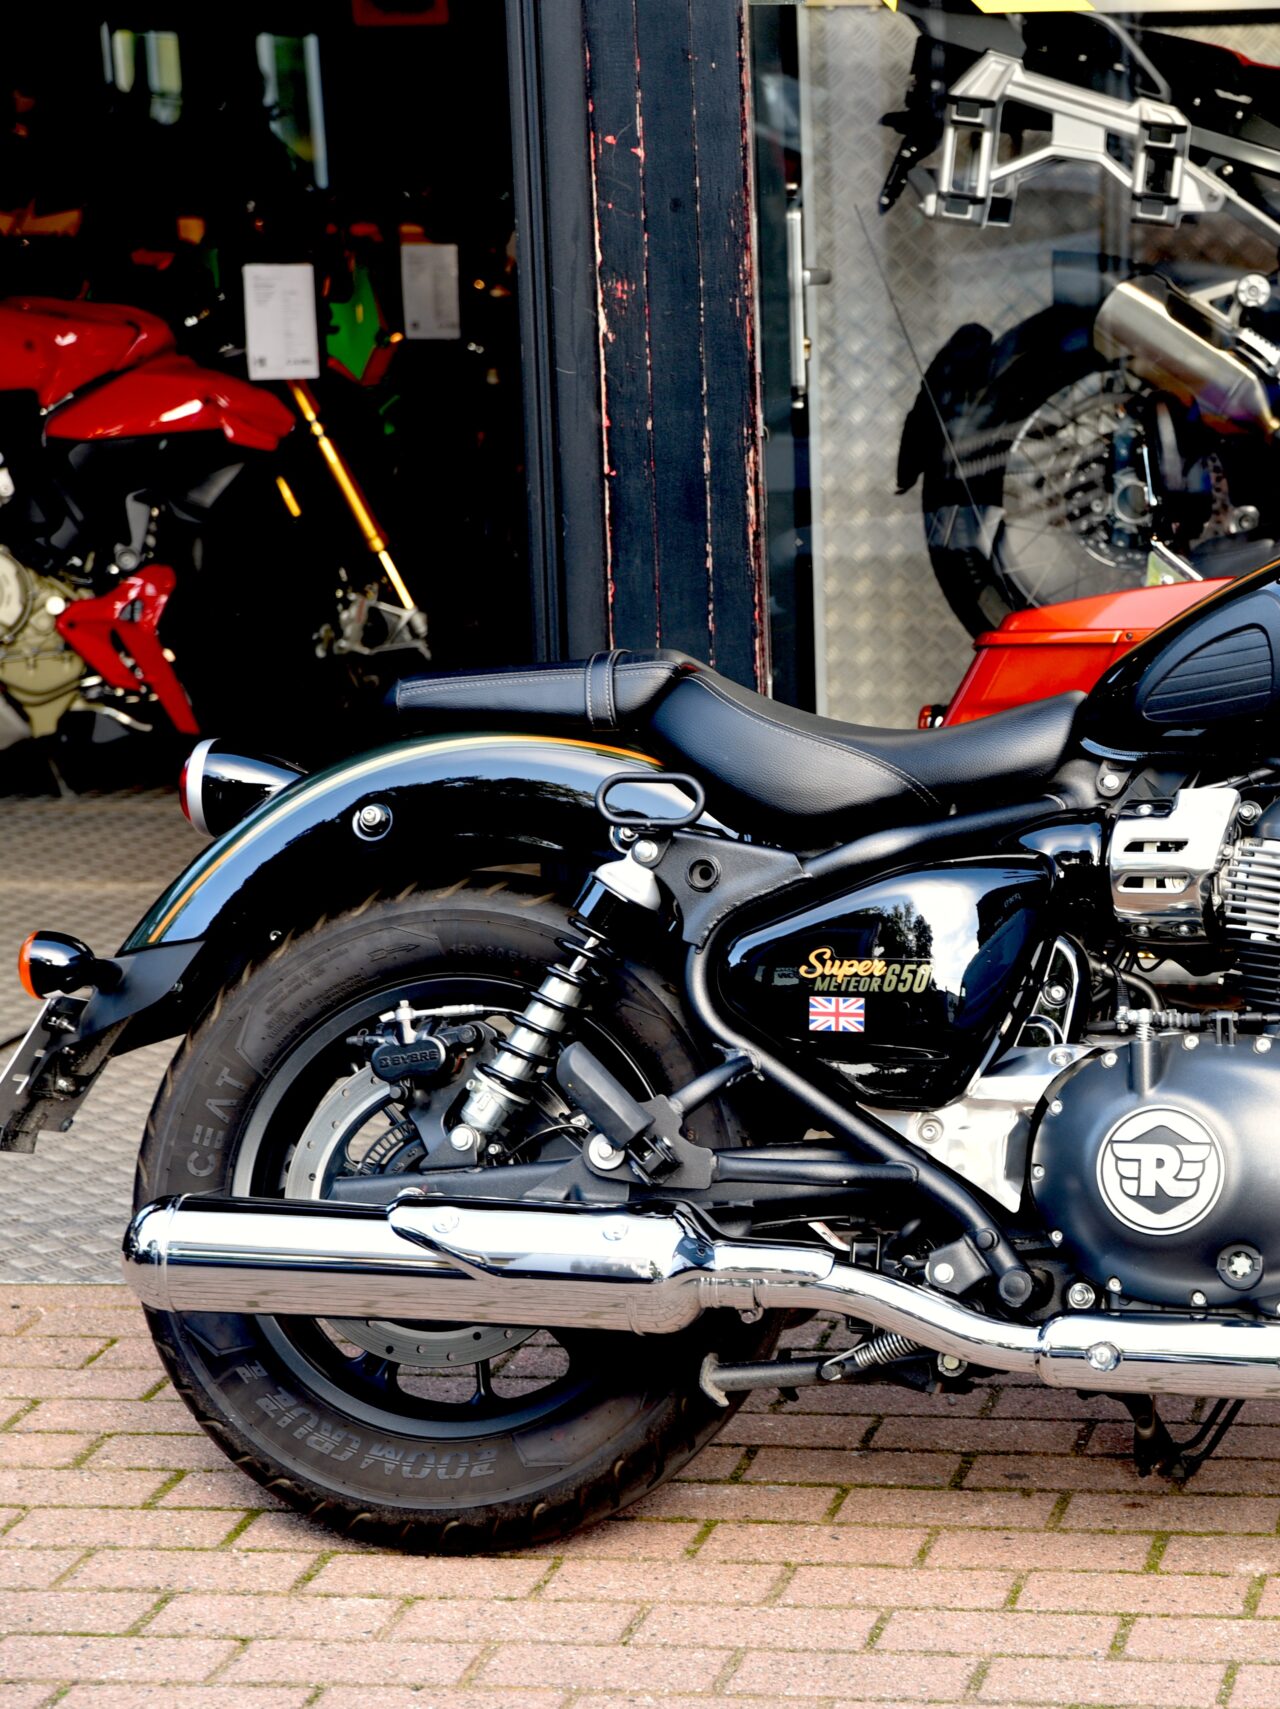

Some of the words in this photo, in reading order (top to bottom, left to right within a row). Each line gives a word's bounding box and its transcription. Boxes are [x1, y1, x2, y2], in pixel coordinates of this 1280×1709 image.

[798, 947, 888, 984] Super
[813, 976, 880, 992] METEOR
[882, 963, 931, 994] 650
[187, 1066, 248, 1177] CEAT
[359, 1443, 497, 1480] ZOOM
